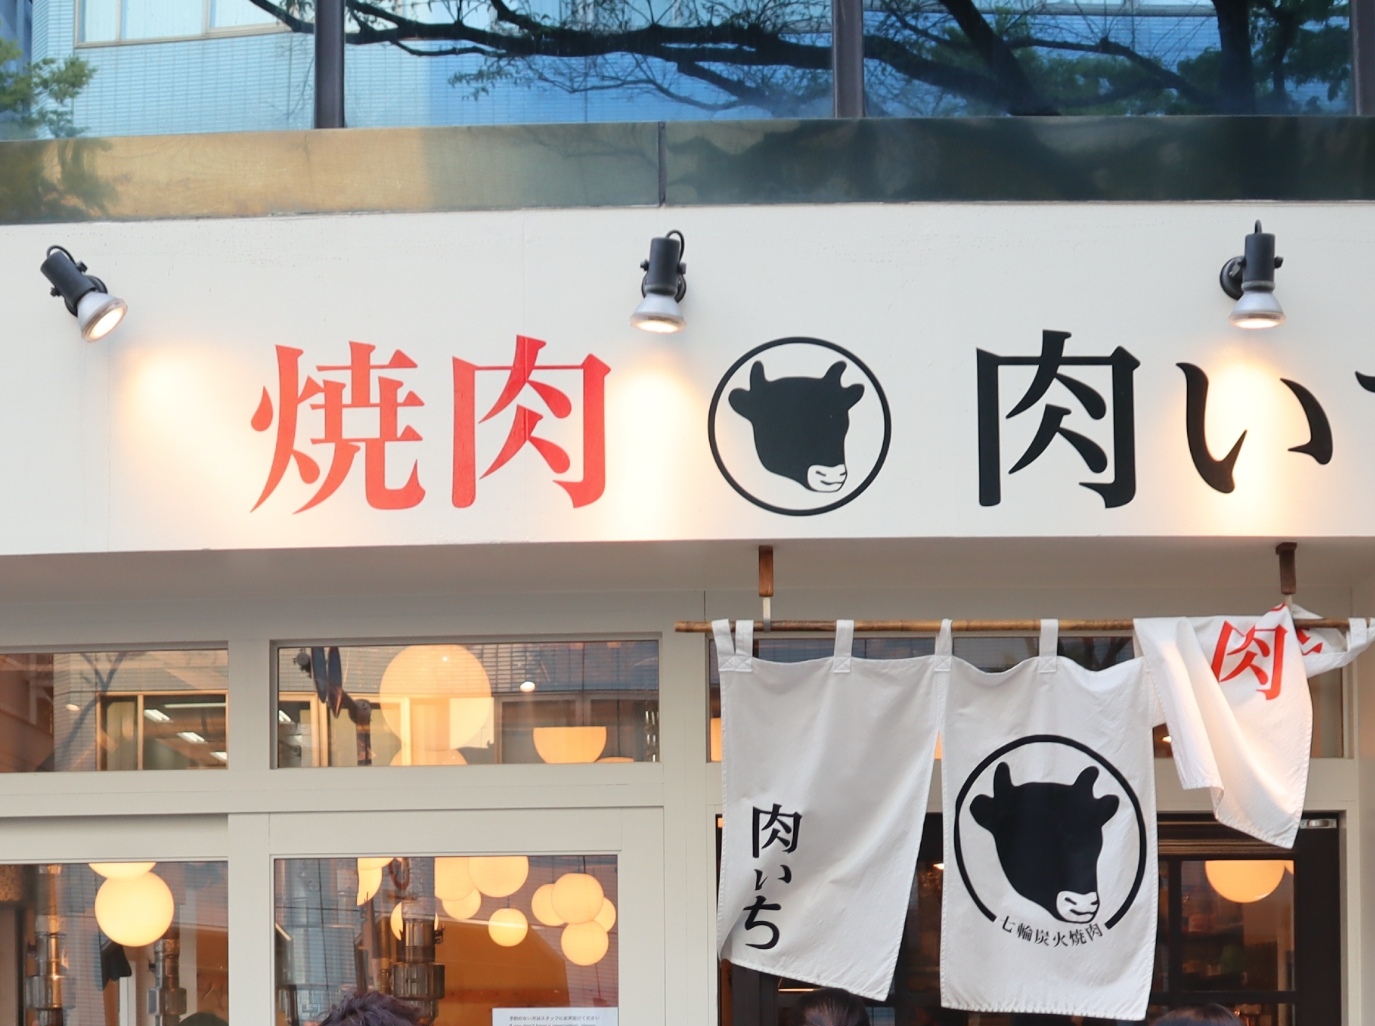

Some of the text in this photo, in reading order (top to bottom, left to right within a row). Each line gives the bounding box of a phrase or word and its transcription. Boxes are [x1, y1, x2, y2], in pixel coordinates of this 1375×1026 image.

[250, 333, 612, 515] 焼肉
[743, 803, 803, 950] 肉いち
[1000, 915, 1103, 947] 七輪炭火焼肉
